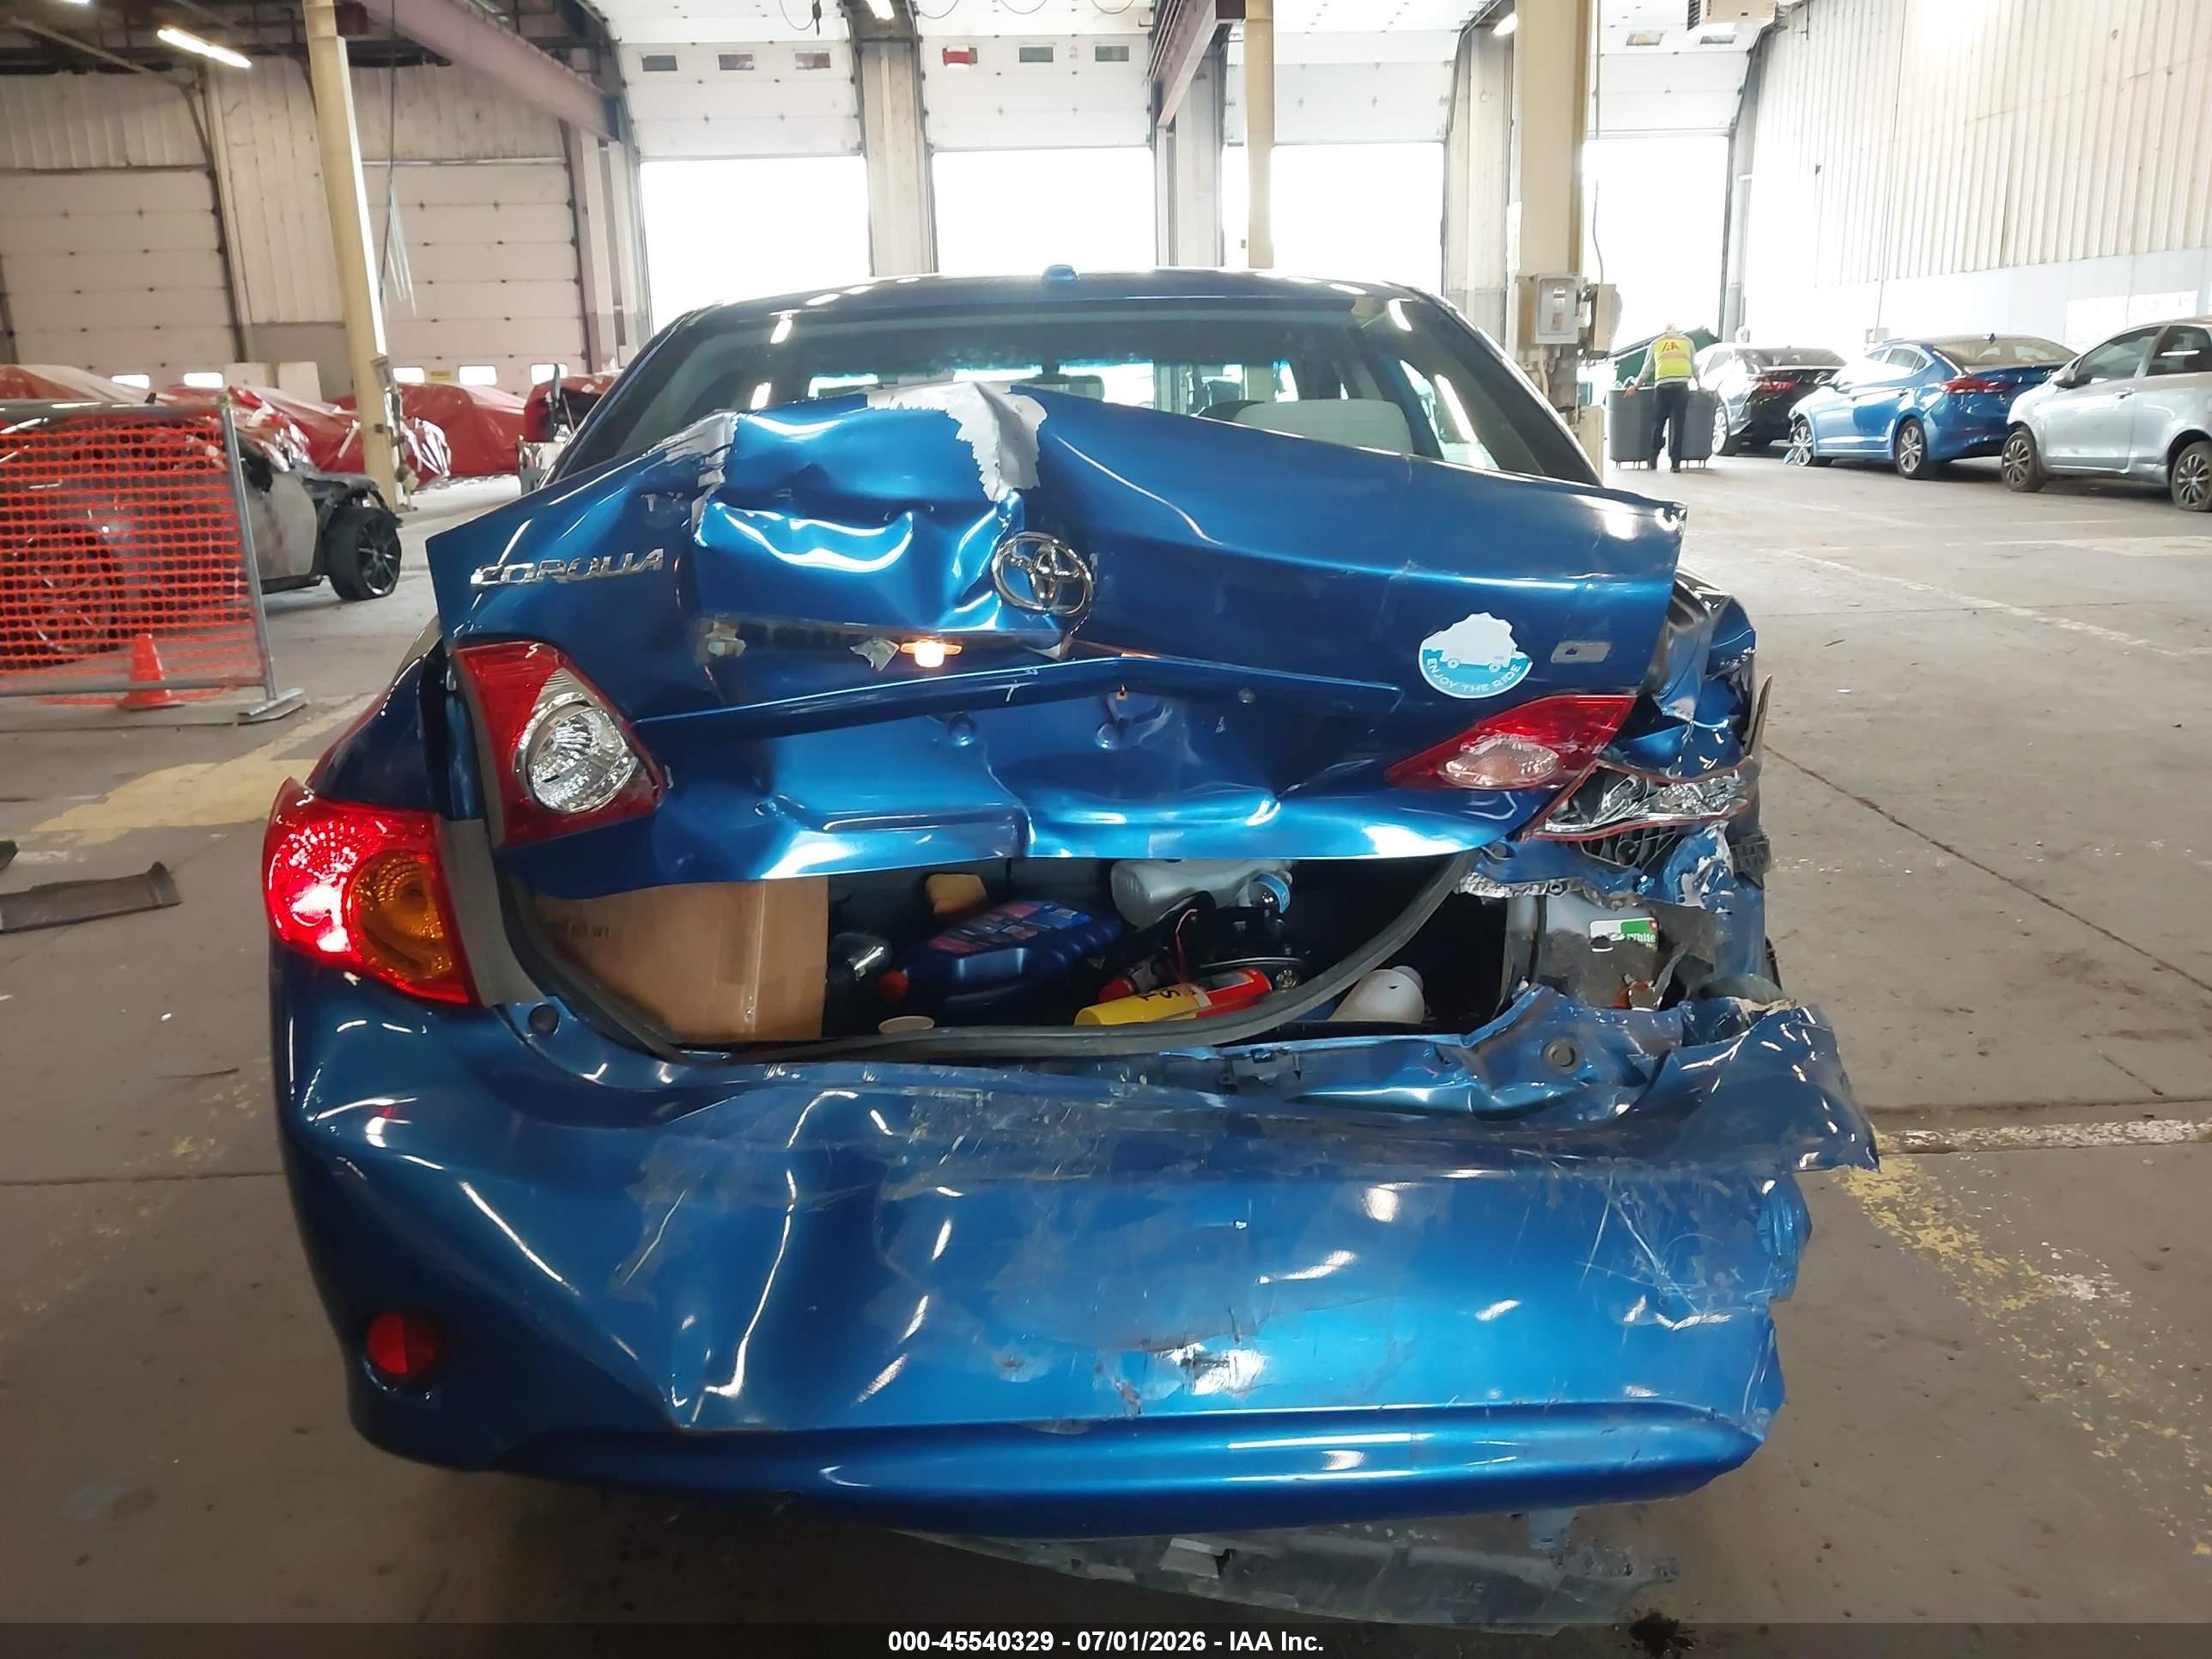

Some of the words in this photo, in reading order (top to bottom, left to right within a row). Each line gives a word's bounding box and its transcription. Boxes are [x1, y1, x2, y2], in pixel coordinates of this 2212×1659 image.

[470, 548, 665, 587] COROLLA
[1426, 658, 1458, 690] ENJOY
[1462, 684, 1490, 693] THE
[1492, 664, 1522, 689] RIDE
